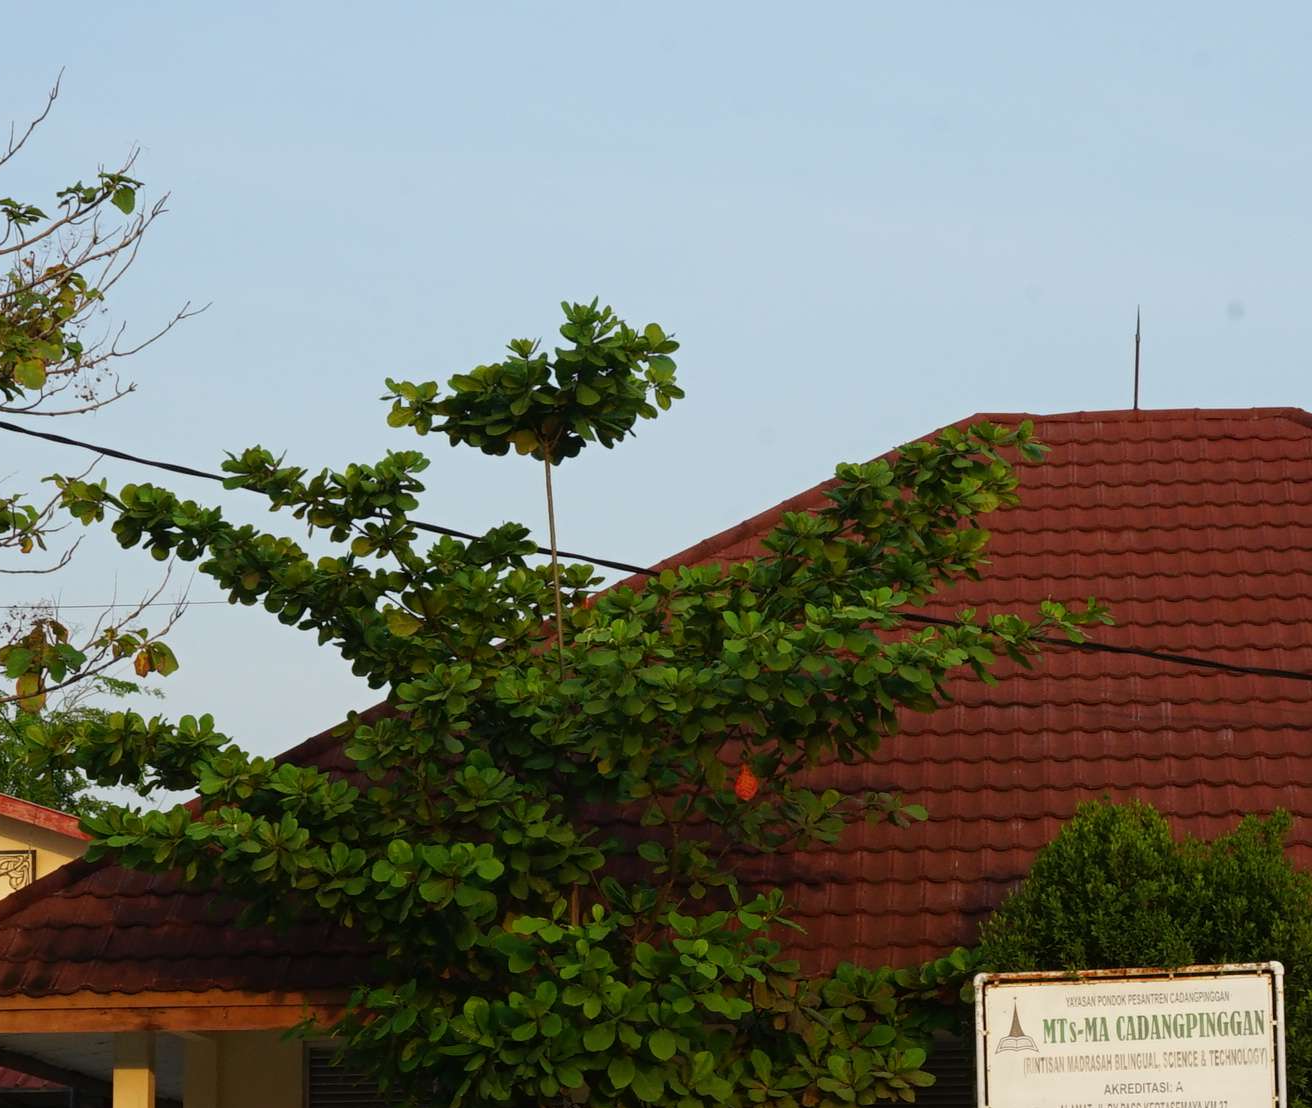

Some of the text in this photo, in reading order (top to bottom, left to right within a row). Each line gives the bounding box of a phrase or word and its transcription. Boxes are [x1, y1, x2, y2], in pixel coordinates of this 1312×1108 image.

[1066, 991, 1230, 1008] YAYASAN PONDOK PESANTREN CADANGPINGGAN
[1042, 1010, 1265, 1043] MTs-MA CADANGPINGGAN
[1024, 1055, 1065, 1077] (RINTISAN
[1068, 1052, 1113, 1074] MADRASAH
[1163, 1049, 1199, 1069] SCIENCE
[1201, 1051, 1208, 1067] &
[1209, 1047, 1267, 1068] TECHNOLOGY)
[1104, 1081, 1184, 1095] AKREDITASI: A
